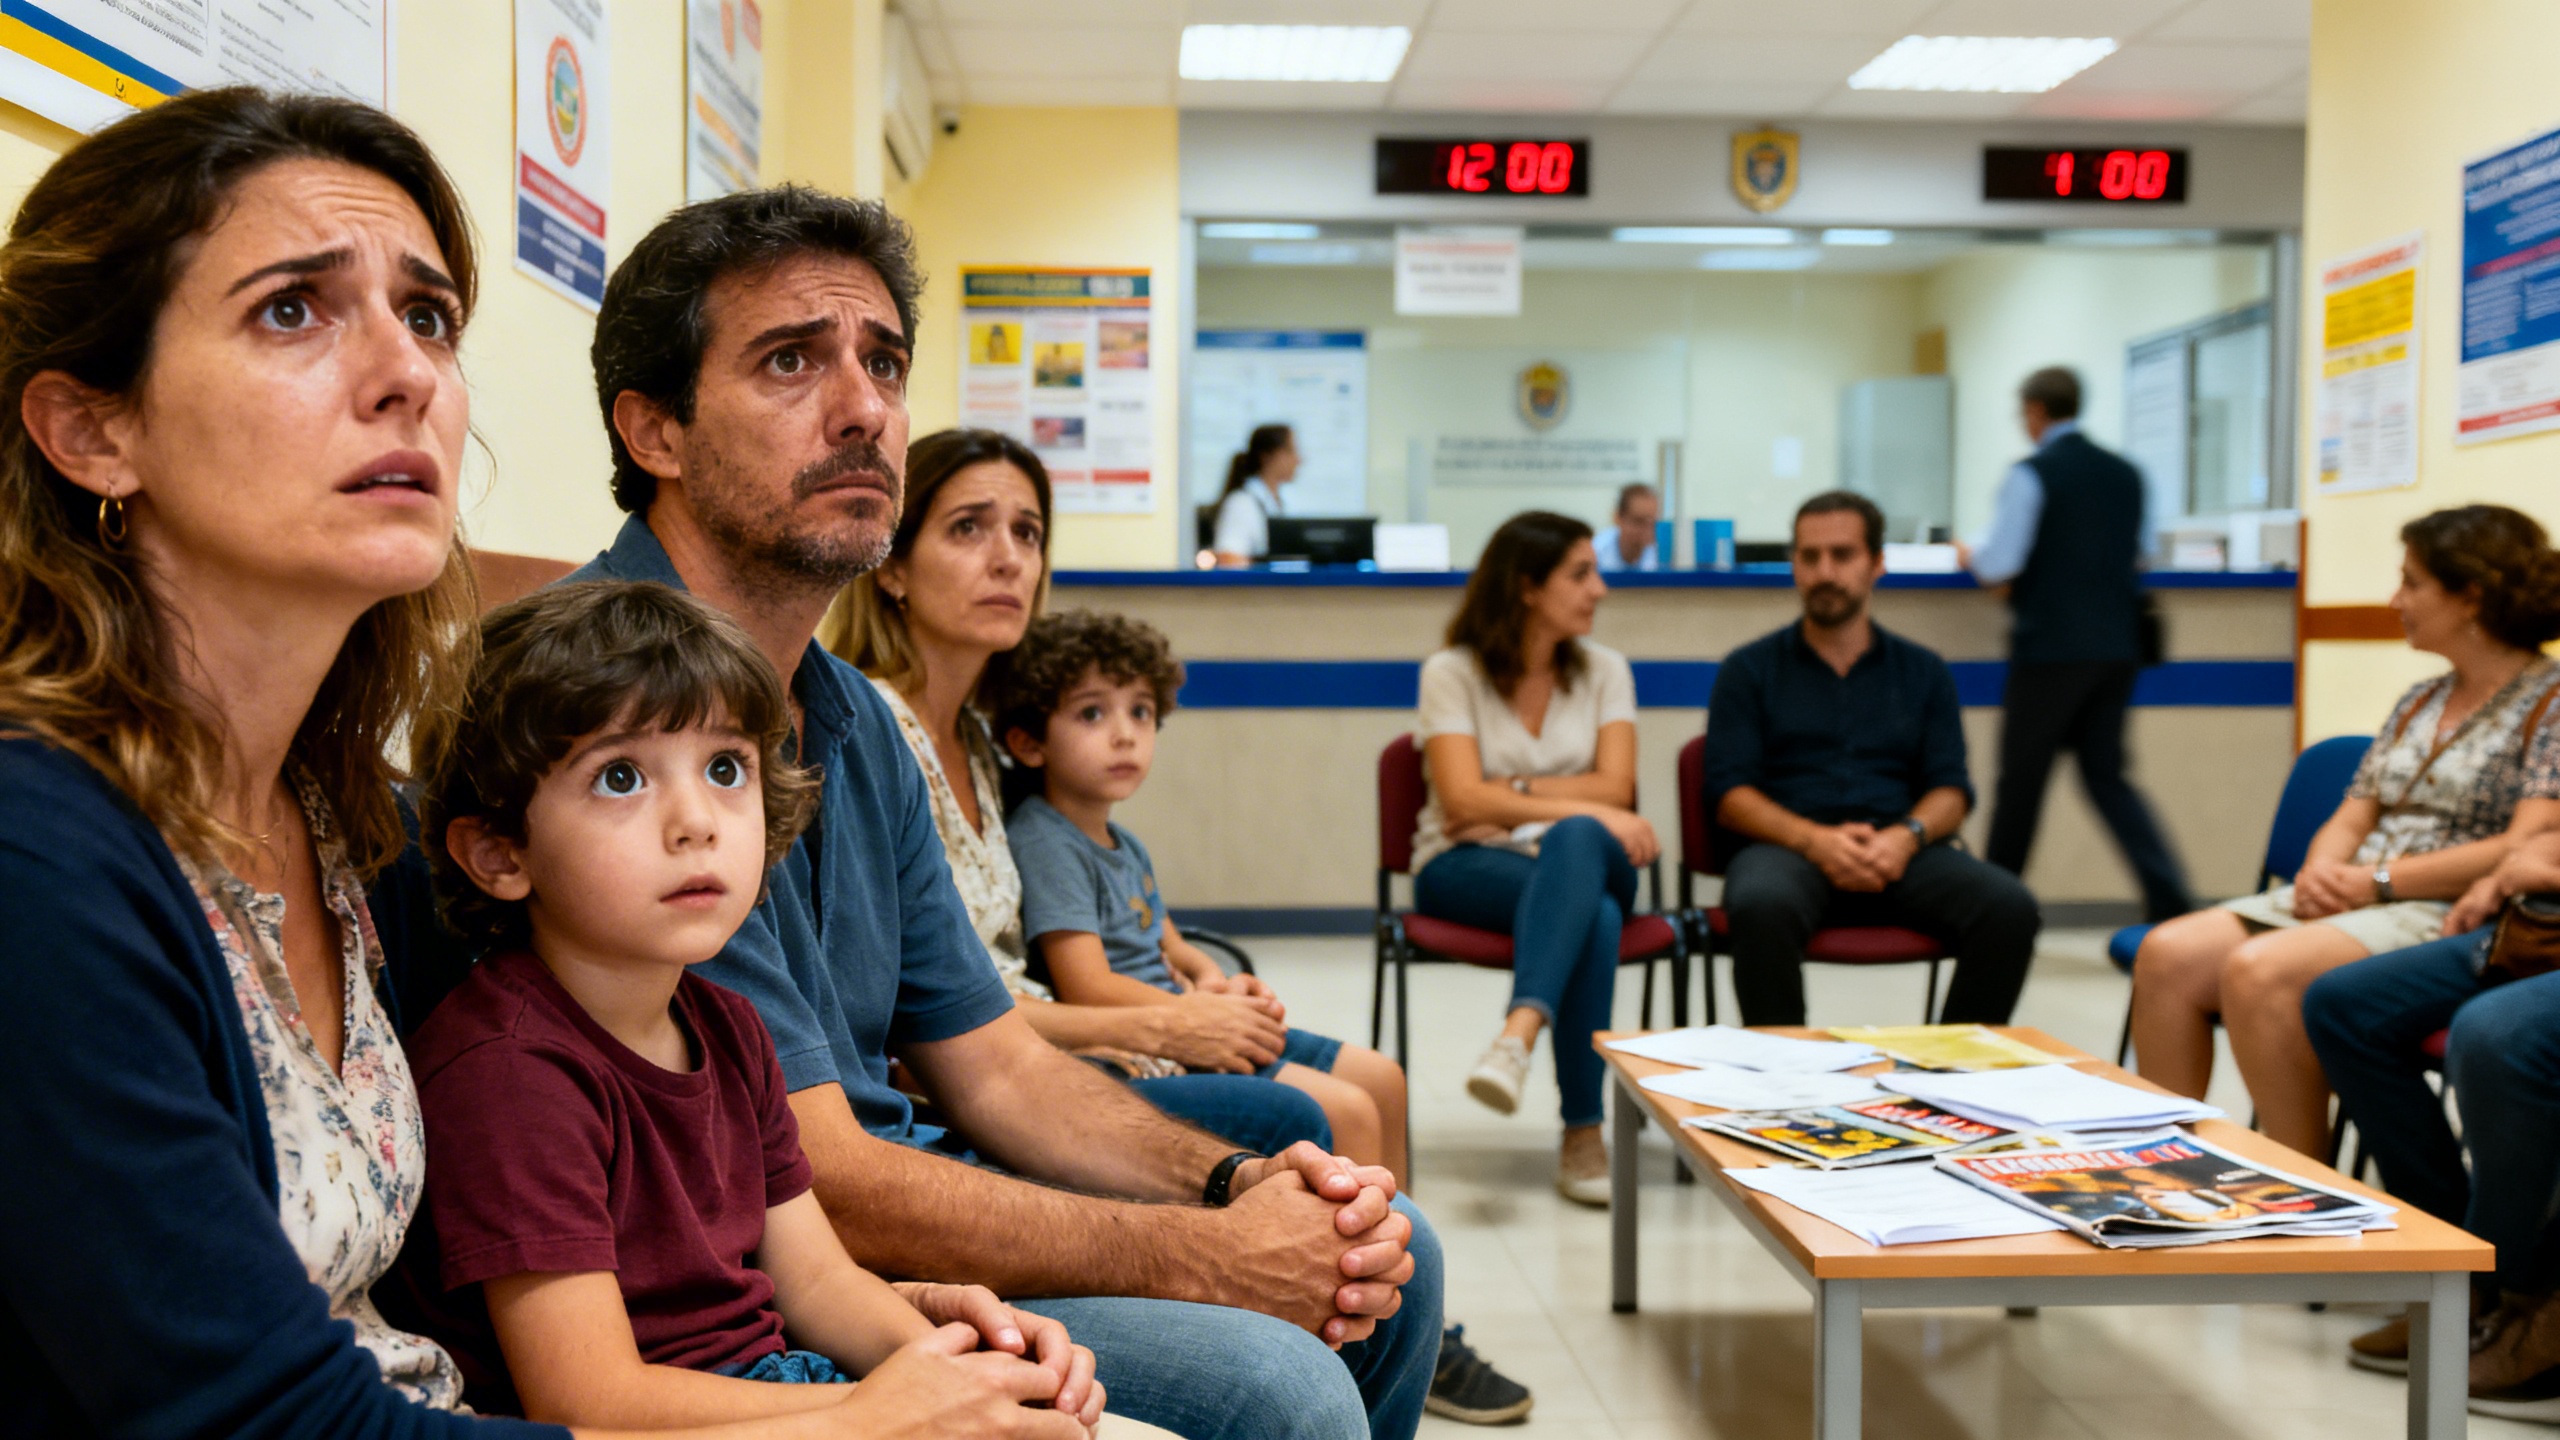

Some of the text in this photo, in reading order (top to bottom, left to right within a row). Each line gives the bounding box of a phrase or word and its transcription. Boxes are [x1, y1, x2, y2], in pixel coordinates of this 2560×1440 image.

[1448, 142, 1573, 193] 12 00
[2100, 151, 2170, 199] 00
